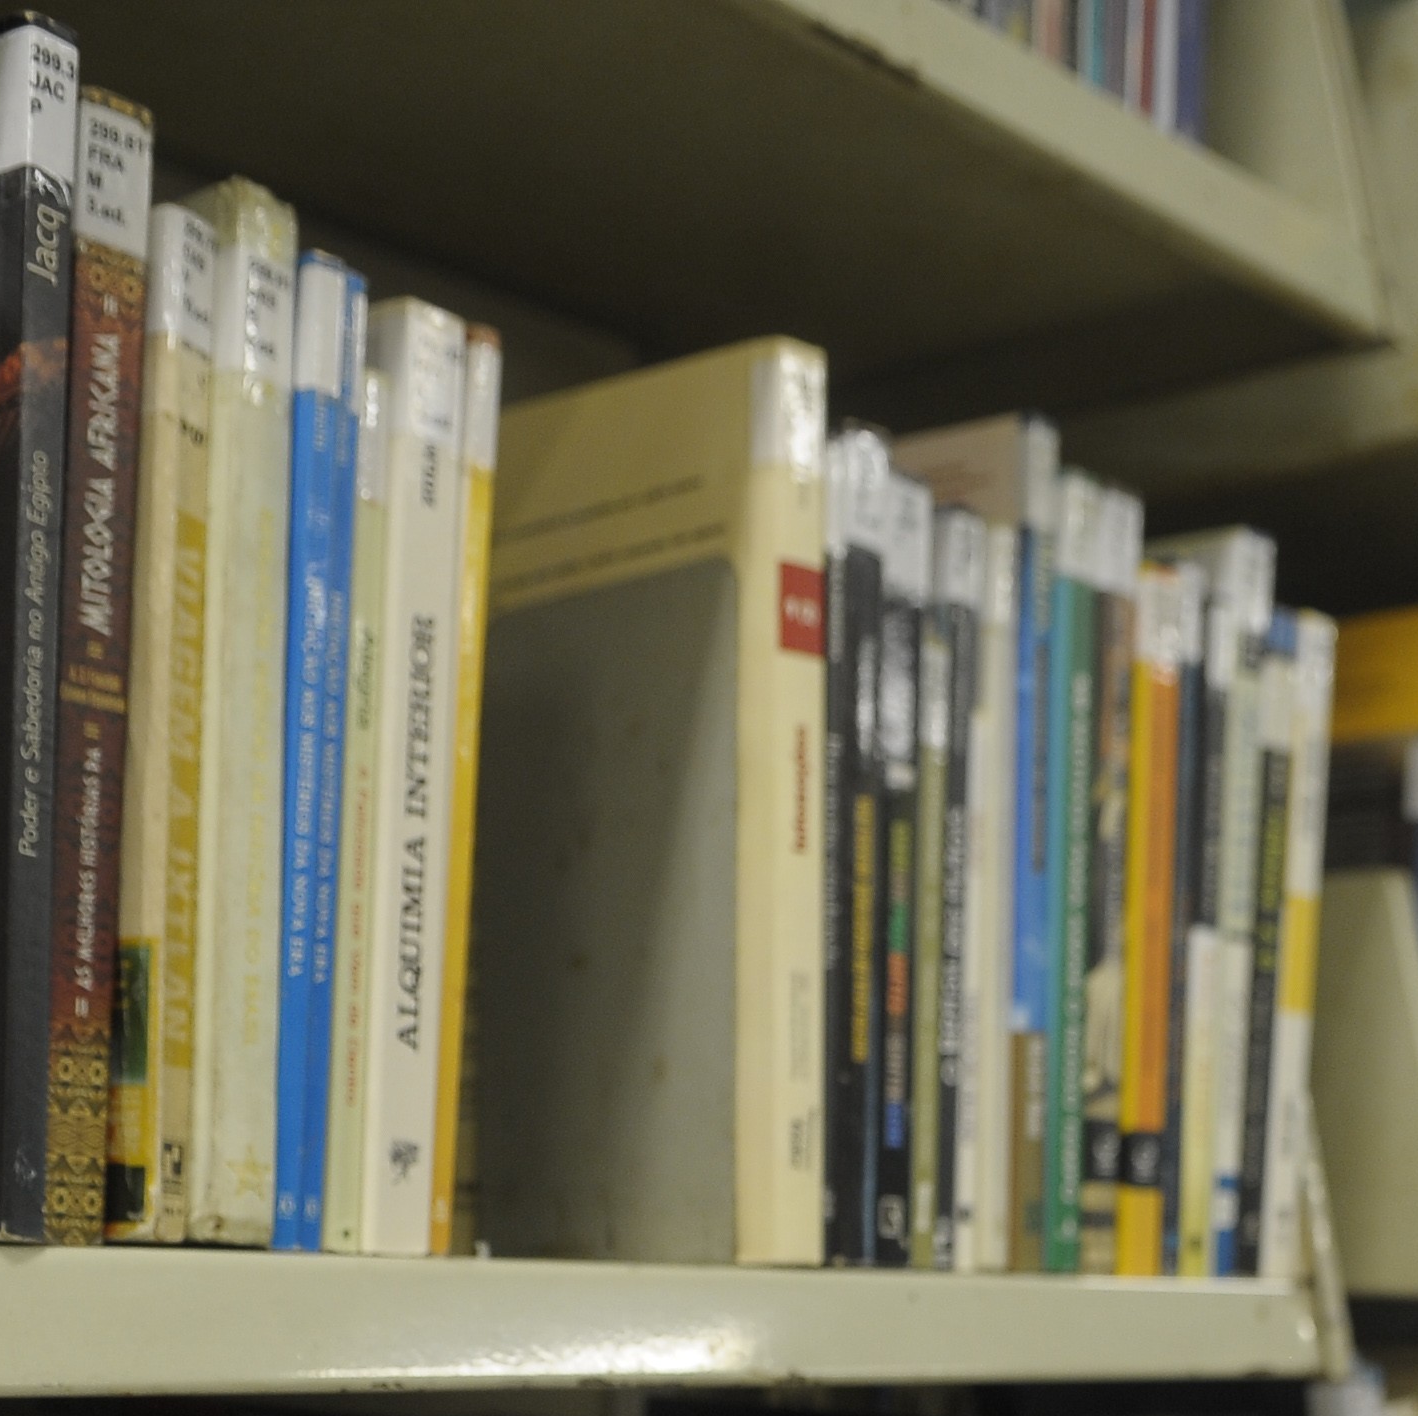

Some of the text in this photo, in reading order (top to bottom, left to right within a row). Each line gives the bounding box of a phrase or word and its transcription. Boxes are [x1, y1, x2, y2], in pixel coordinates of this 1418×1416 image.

[80, 477, 115, 636] MITOLOGIA
[27, 608, 46, 640] no
[18, 645, 45, 762] Sabedoria
[18, 786, 42, 858] Poder
[396, 836, 427, 1053] ALQUIMIA
